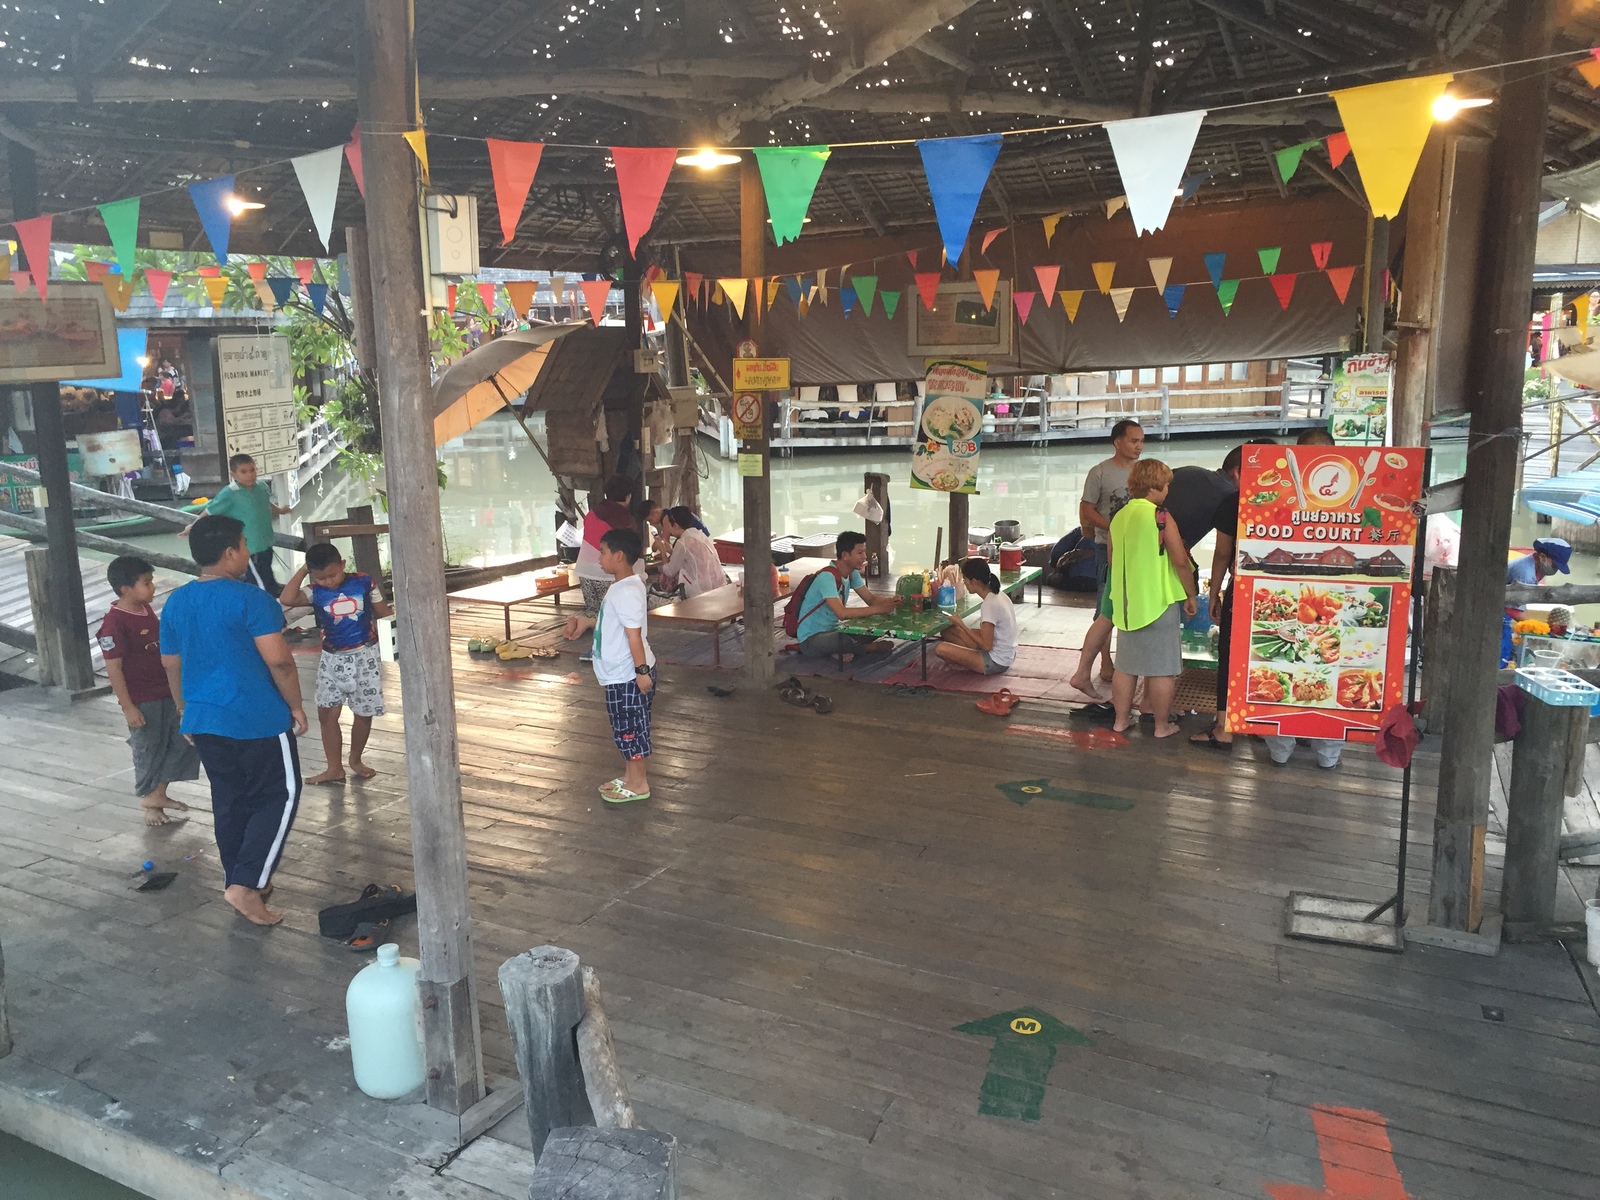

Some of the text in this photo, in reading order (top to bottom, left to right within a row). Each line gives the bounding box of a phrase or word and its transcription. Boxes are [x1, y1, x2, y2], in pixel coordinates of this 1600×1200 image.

[224, 369, 269, 379] FLOATING MARKET
[1291, 509, 1362, 525] ศูนย์อาหาร
[1246, 524, 1294, 539] FOOD
[1303, 526, 1363, 541] COURT
[1016, 1021, 1036, 1031] M
